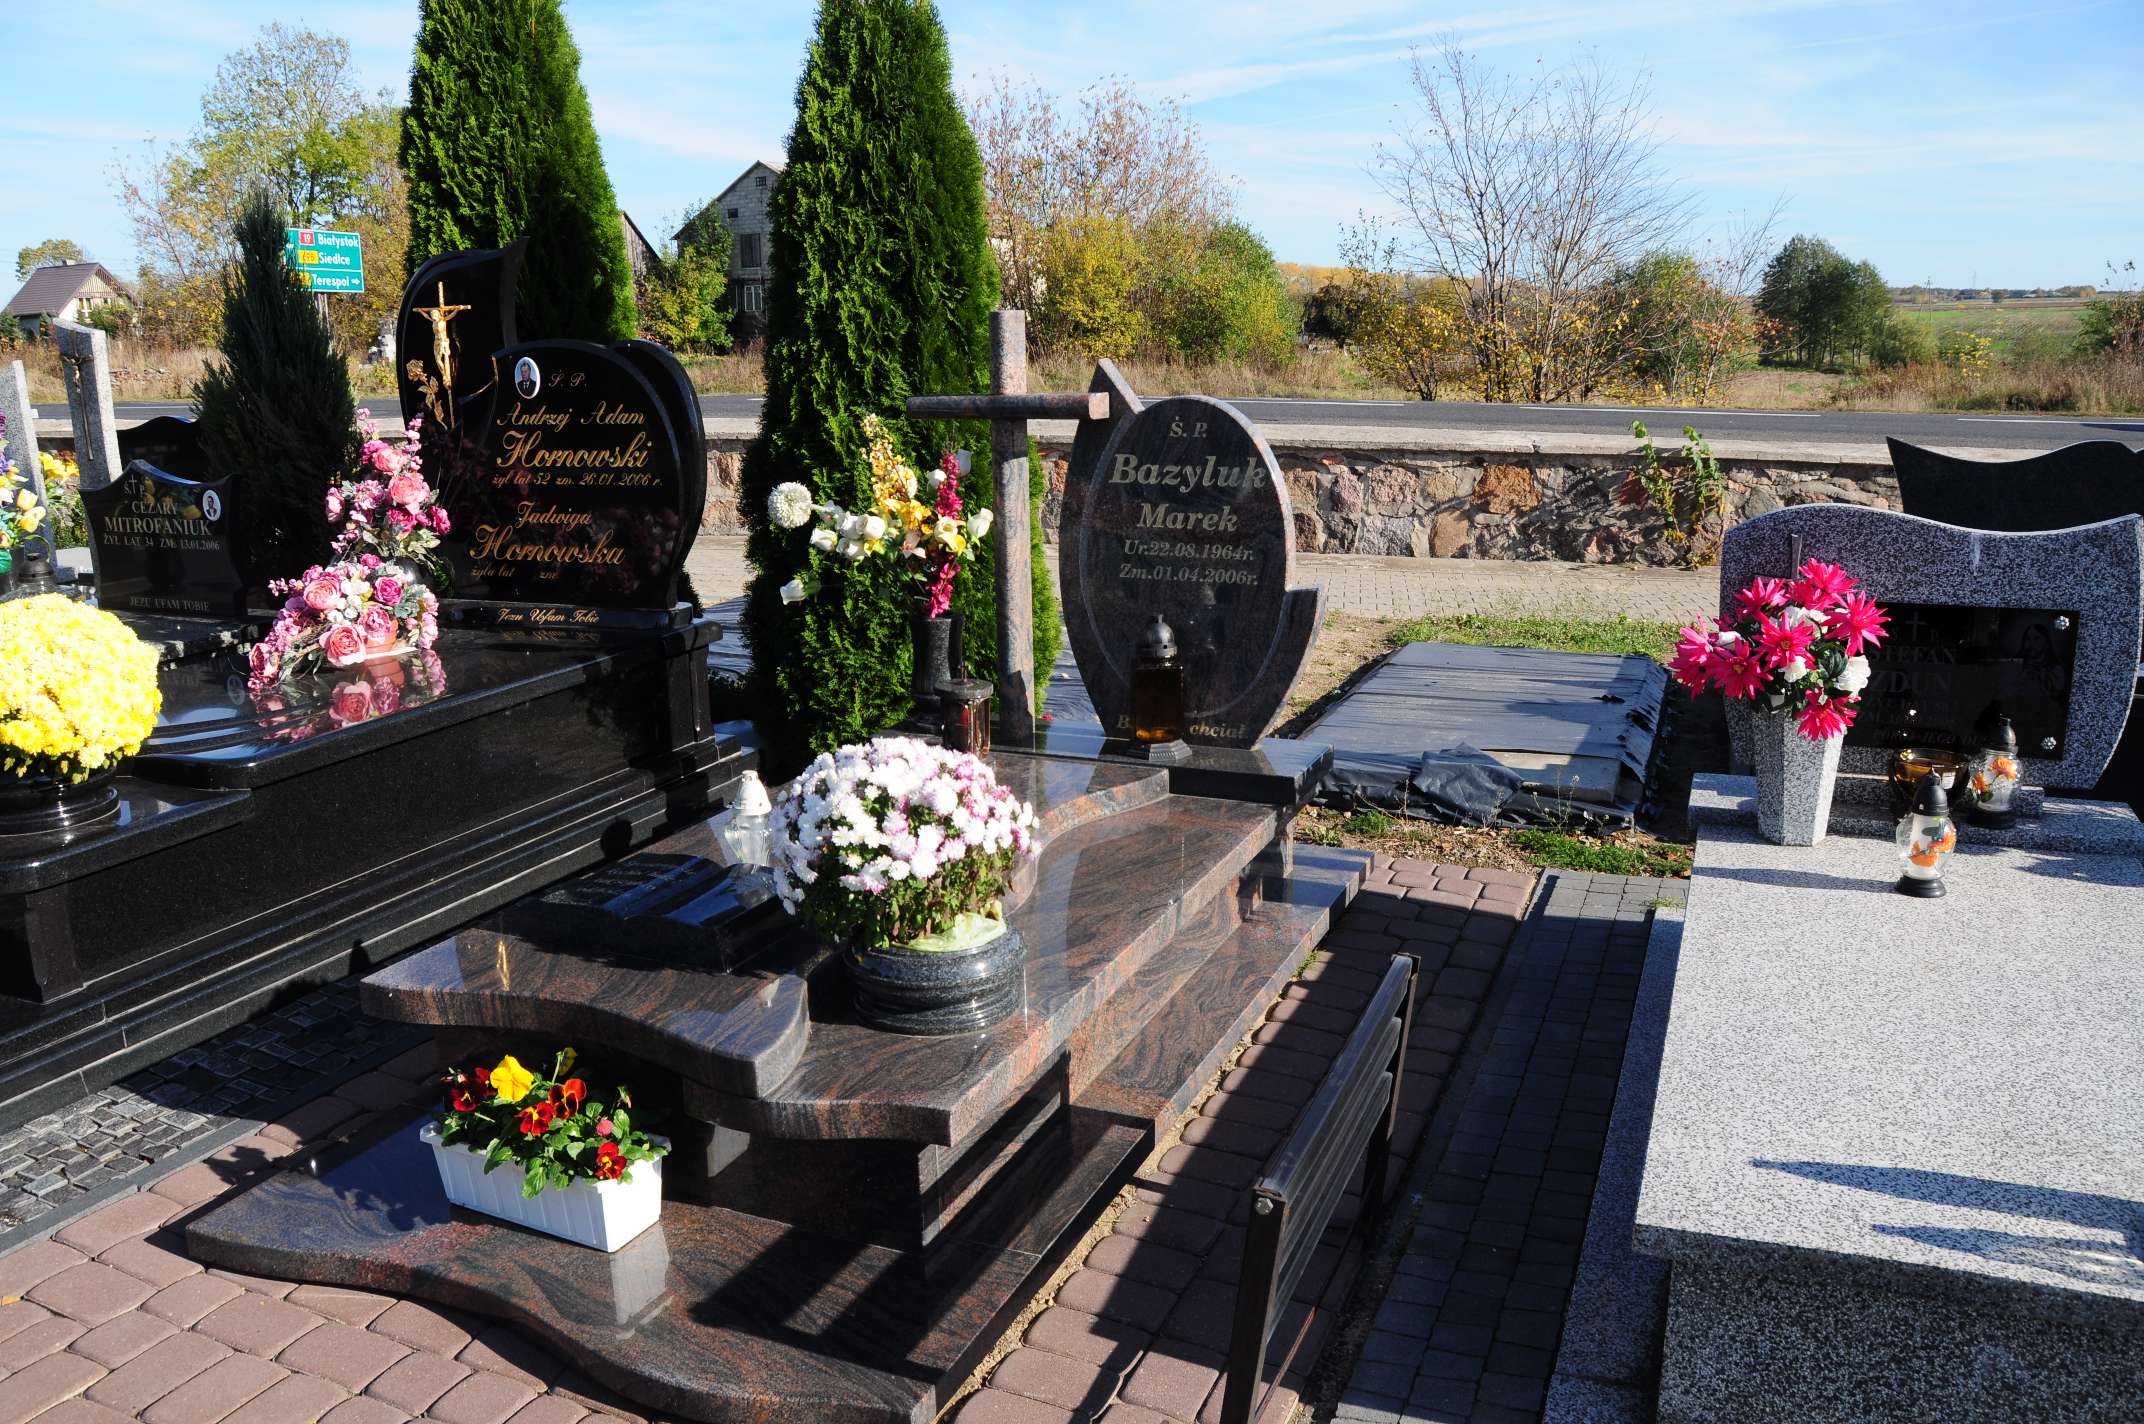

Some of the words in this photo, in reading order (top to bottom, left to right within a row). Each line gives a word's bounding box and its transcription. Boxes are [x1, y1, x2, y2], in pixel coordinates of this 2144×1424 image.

[318, 233, 358, 248] Białystok
[319, 252, 350, 265] Siedlce
[312, 274, 349, 288] Terespol
[497, 402, 573, 432] Andrzej
[580, 400, 646, 426] Adam
[496, 430, 652, 468] Hornowski
[1109, 453, 1268, 494] Bazyluk
[131, 501, 178, 517] CEZARY
[515, 501, 593, 529] Jadwiga
[1136, 503, 1241, 533] Marek
[104, 516, 212, 537] MITROFANIUK
[124, 537, 142, 546] LAT
[469, 524, 625, 565] Hornowska
[155, 598, 180, 610] UFAM
[182, 600, 210, 612] TOBIE
